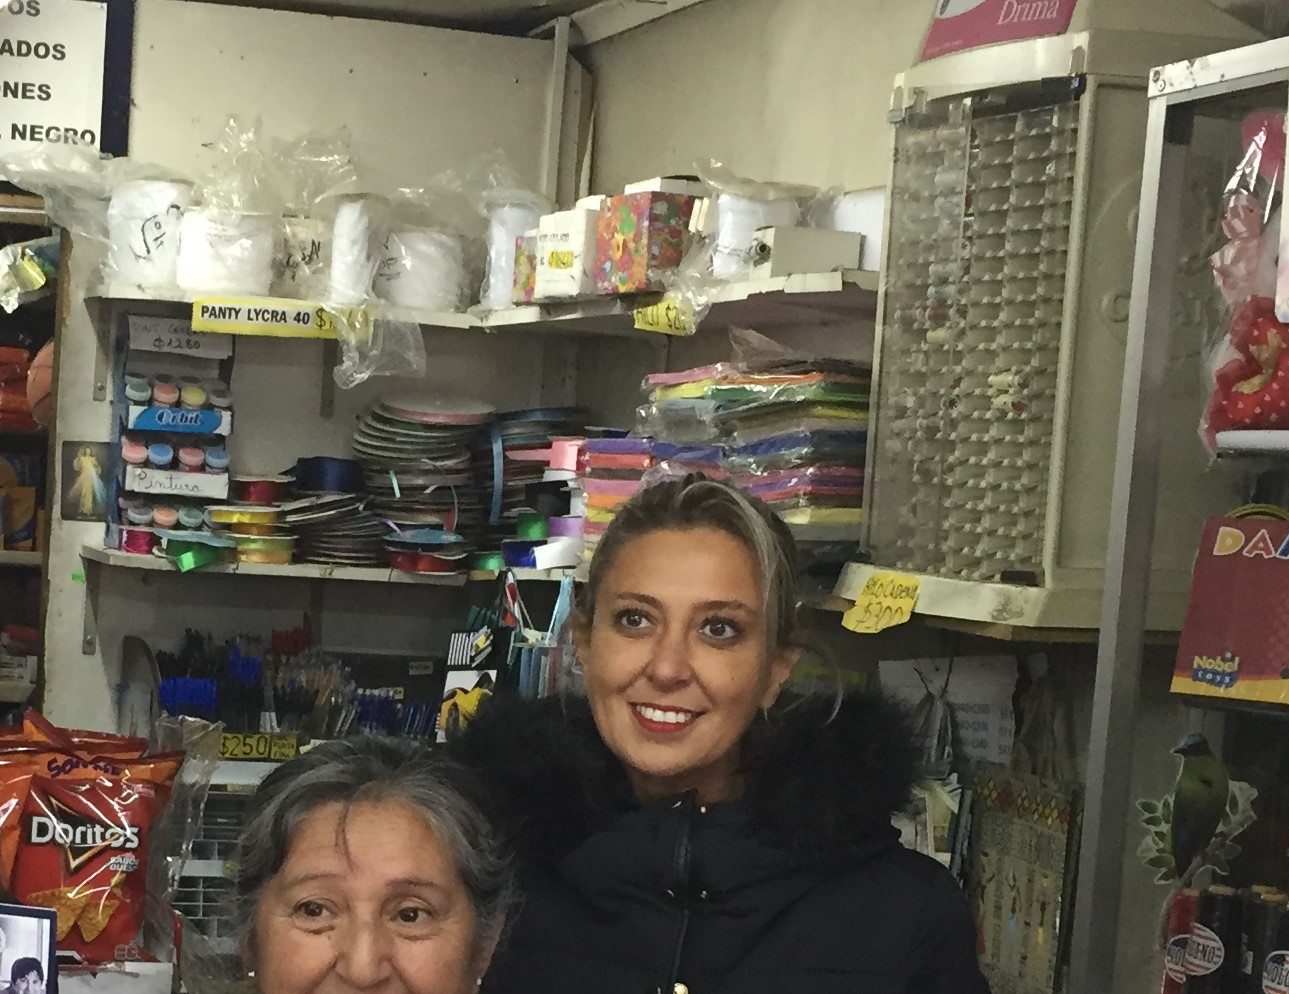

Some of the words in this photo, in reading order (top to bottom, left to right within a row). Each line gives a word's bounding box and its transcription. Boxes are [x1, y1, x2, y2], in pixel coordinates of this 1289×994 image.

[997, 0, 1060, 27] Drima
[11, 123, 96, 147] NEGRO
[201, 305, 242, 320] PANTY
[247, 309, 287, 323] LYCRA
[293, 311, 310, 325] 40
[155, 409, 203, 426] Orbit
[219, 735, 268, 757] $250
[31, 816, 140, 848] Doritos
